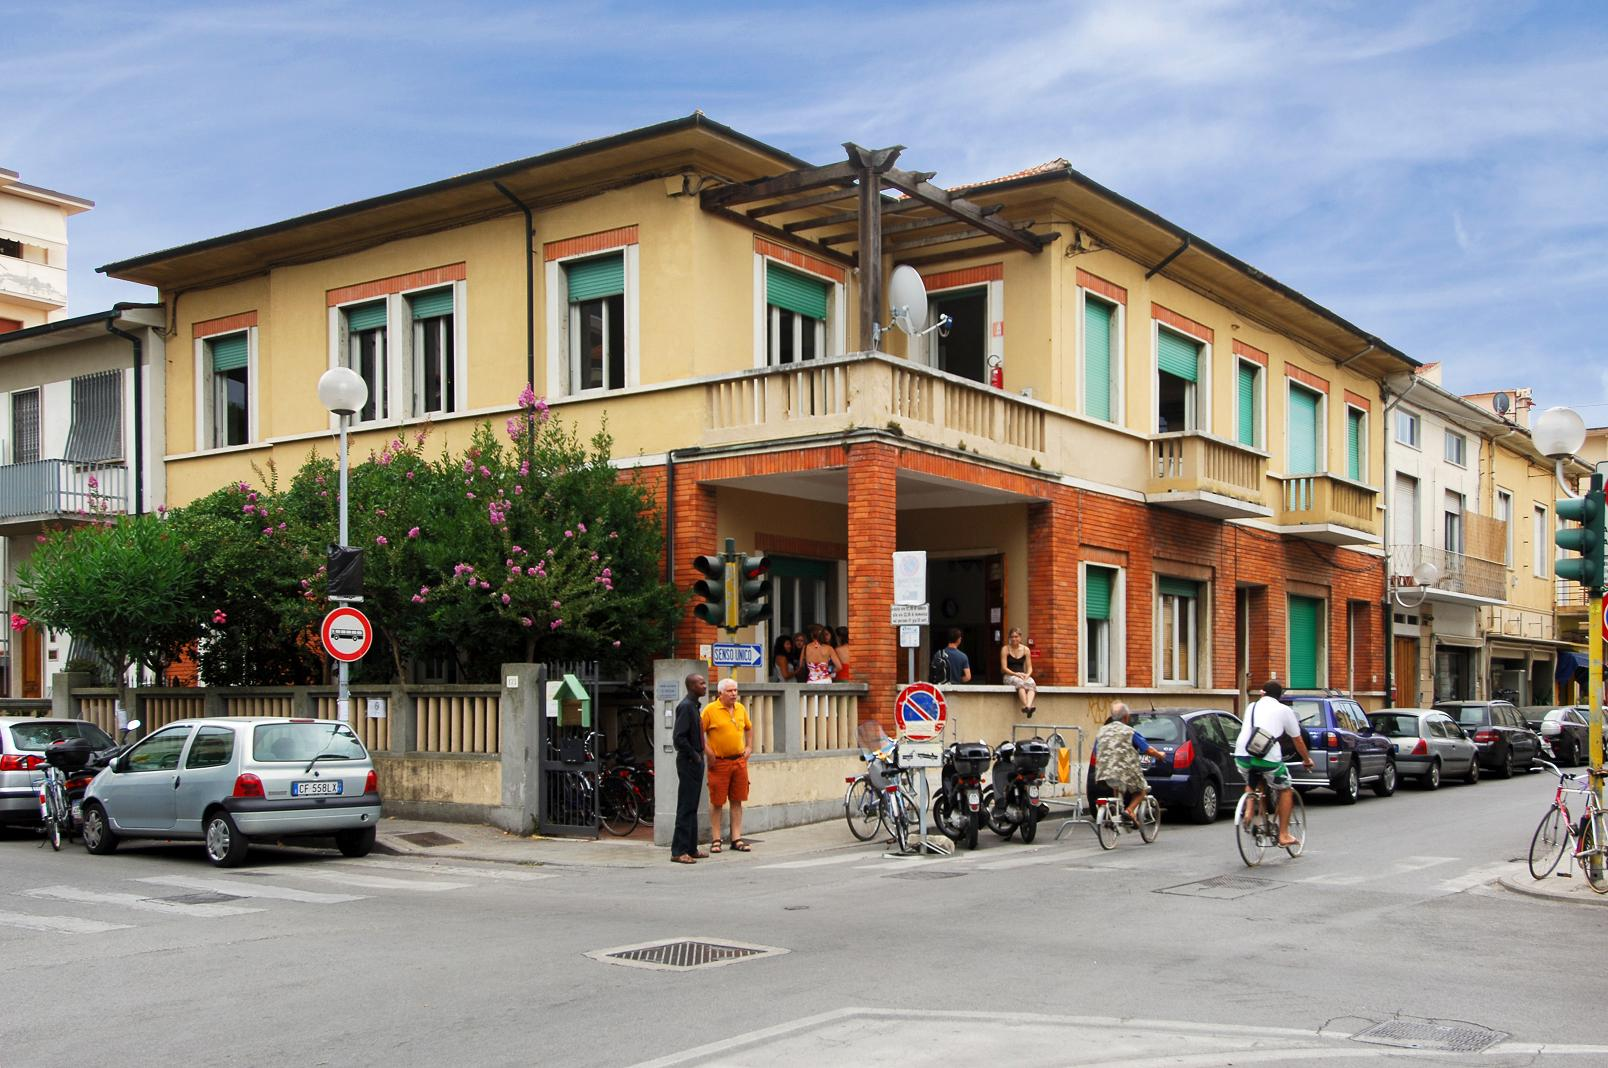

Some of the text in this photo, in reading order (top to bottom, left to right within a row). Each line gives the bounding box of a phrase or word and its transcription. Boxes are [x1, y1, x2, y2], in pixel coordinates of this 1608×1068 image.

[714, 649, 734, 661] SENSO
[736, 649, 751, 661] UNICO
[299, 784, 309, 793] CF
